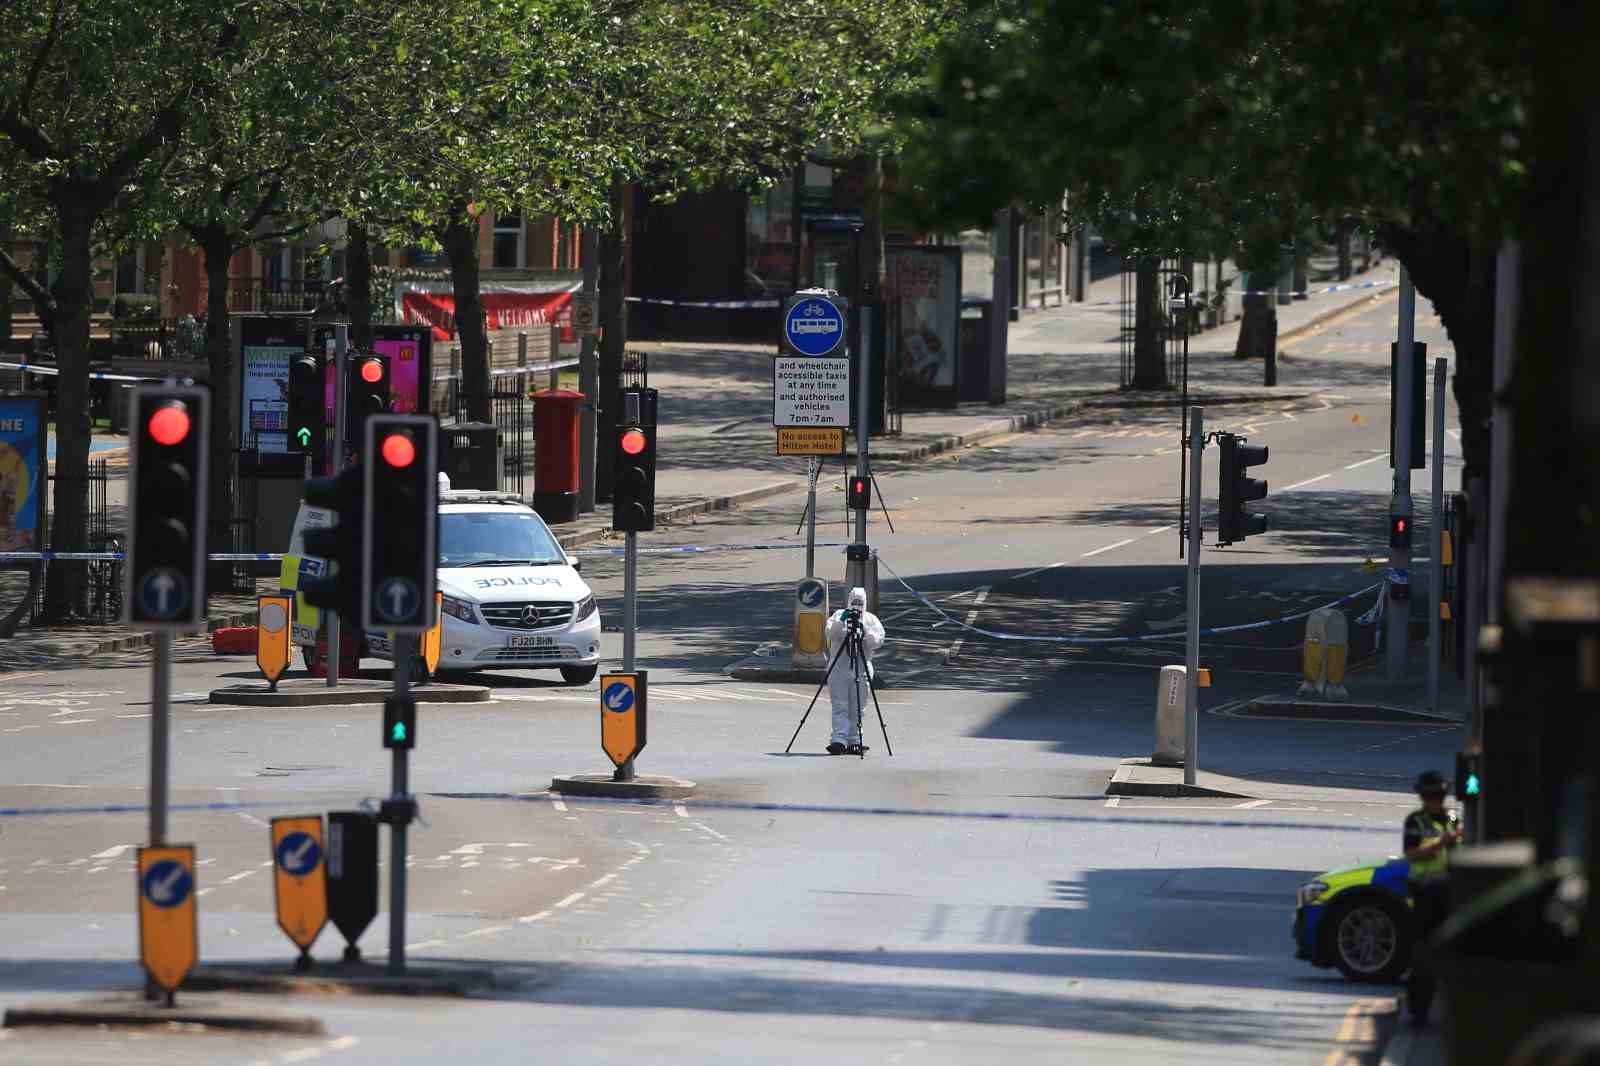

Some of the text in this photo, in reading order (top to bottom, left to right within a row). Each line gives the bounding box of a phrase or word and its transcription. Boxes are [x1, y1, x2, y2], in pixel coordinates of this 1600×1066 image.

[498, 308, 546, 328] WELCOME
[779, 362, 846, 370] and wheelchair
[778, 371, 847, 380] accessible taxis
[787, 381, 838, 391] at any time
[779, 393, 845, 401] and authorised
[794, 403, 831, 411] vehicles
[782, 432, 794, 440] No
[829, 432, 839, 440] to
[782, 441, 837, 450] Hilton Hotel
[511, 635, 553, 647] FJ20 BHN
